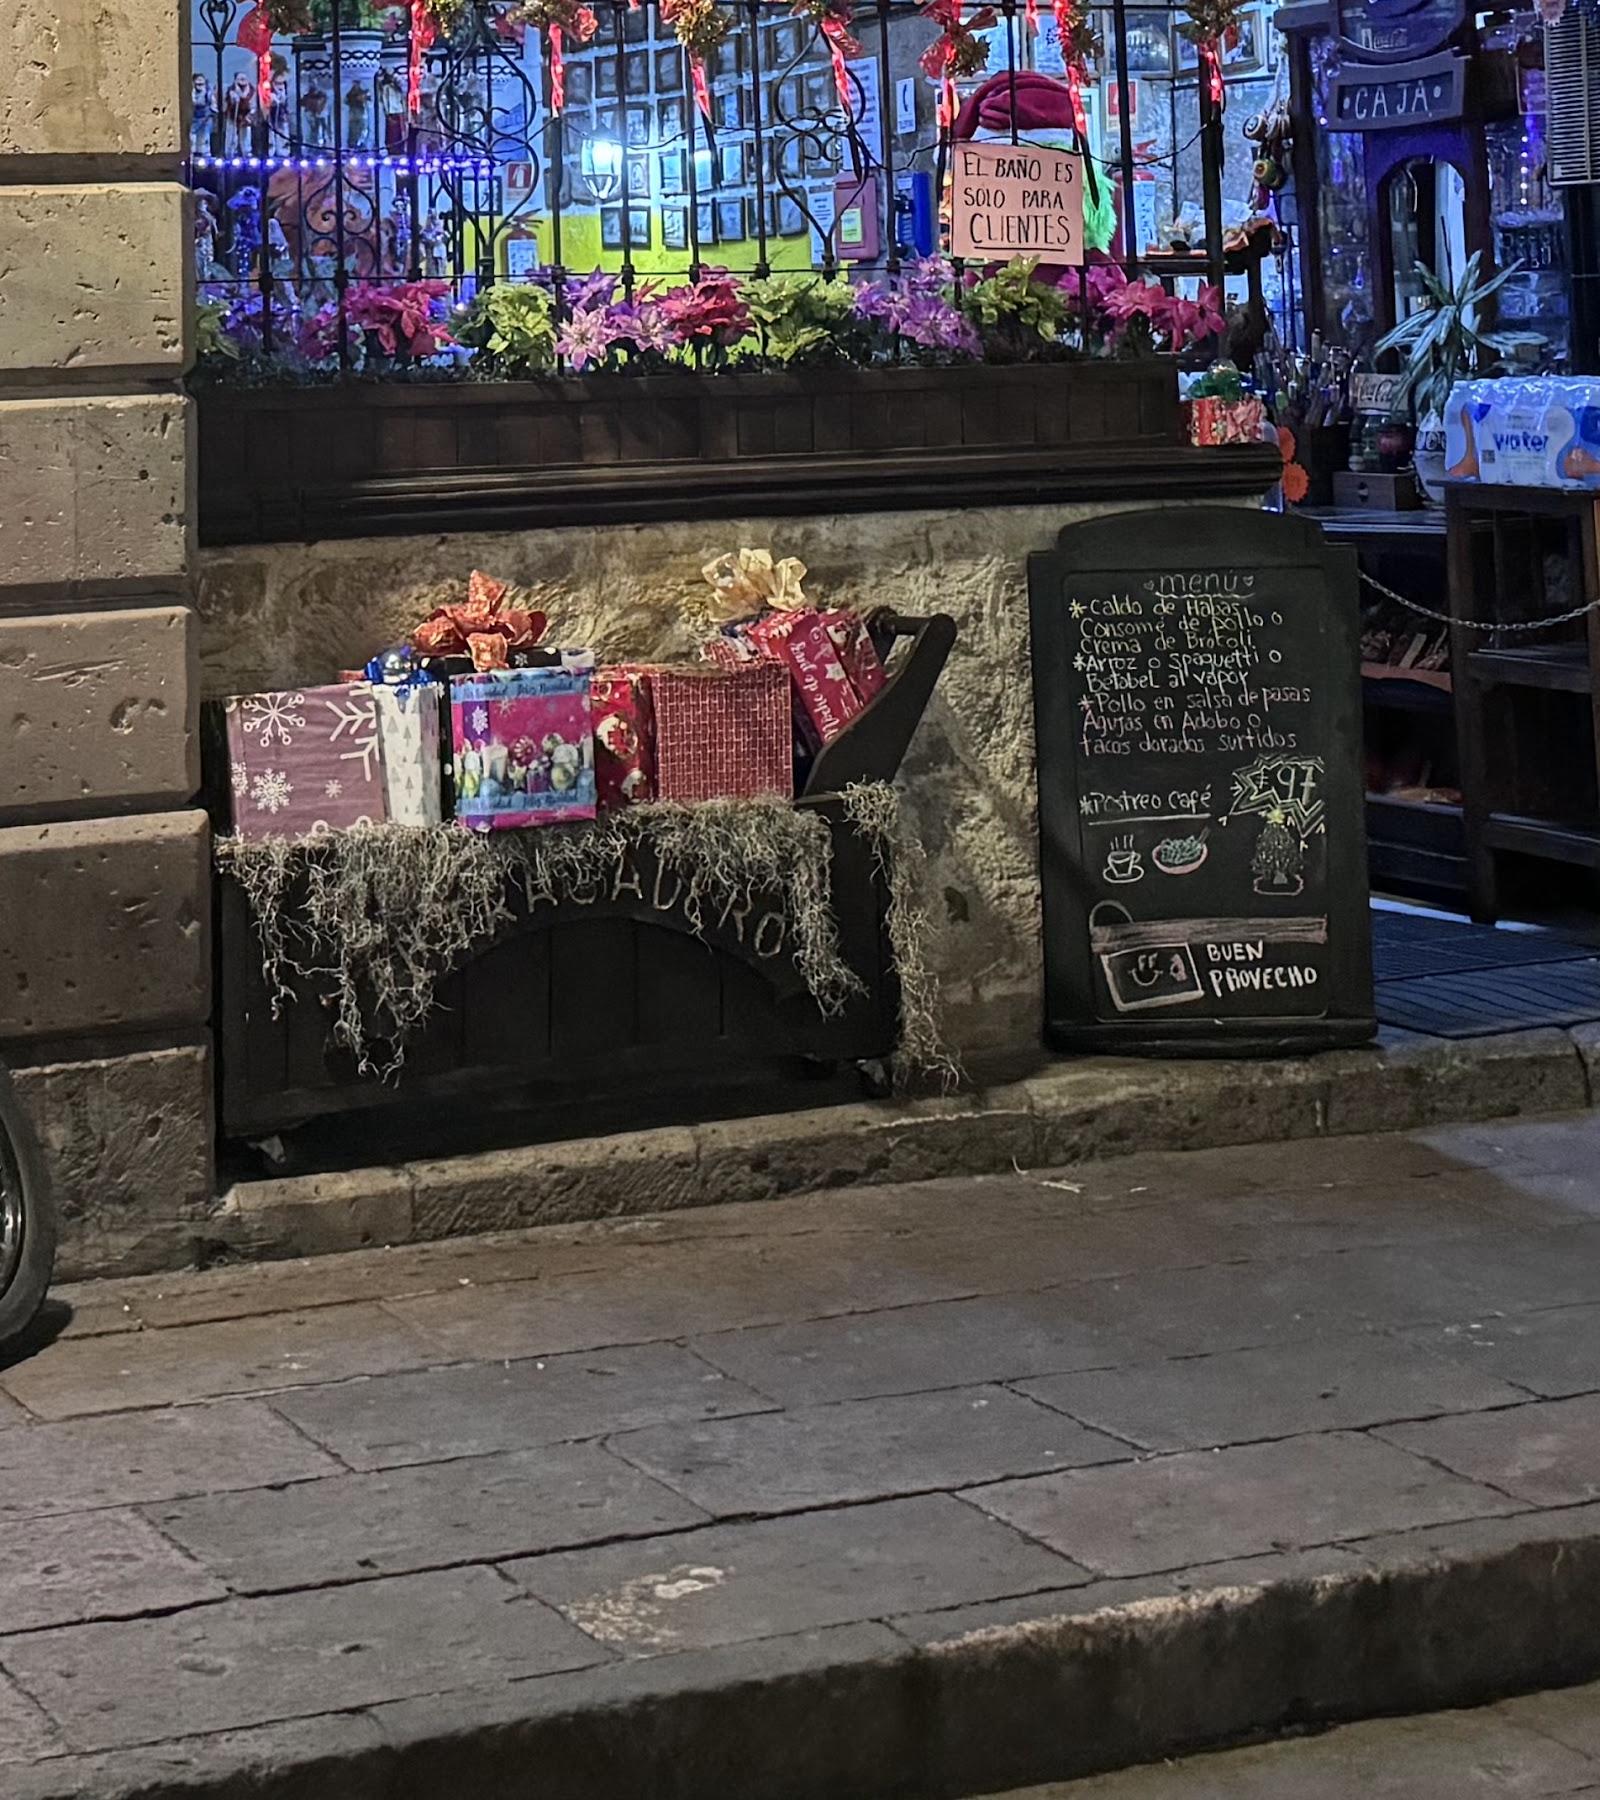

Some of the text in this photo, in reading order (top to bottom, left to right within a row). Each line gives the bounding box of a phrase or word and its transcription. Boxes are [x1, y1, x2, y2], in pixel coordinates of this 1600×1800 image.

[1355, 80, 1428, 120] CAJA
[963, 152, 1073, 184] EL BAÑO ES
[964, 187, 1064, 210] SOLO PARA
[970, 213, 1070, 245] CLIENTES
[1090, 595, 1240, 617] Caldo de Habas
[1179, 616, 1200, 631] de
[1080, 638, 1142, 655] Crema
[1155, 634, 1176, 651] de
[1086, 655, 1138, 675] Arroz
[1168, 669, 1185, 687] al
[1095, 686, 1311, 714] Pollo en salsa de pasas
[1083, 709, 1143, 737] Agujas
[1154, 715, 1174, 730] en
[1182, 710, 1241, 732] Adobo
[1139, 731, 1205, 754] dorados
[1218, 726, 1297, 751] surtidos
[1207, 939, 1263, 962] BUEN
[1209, 965, 1318, 998] PROVECHO
